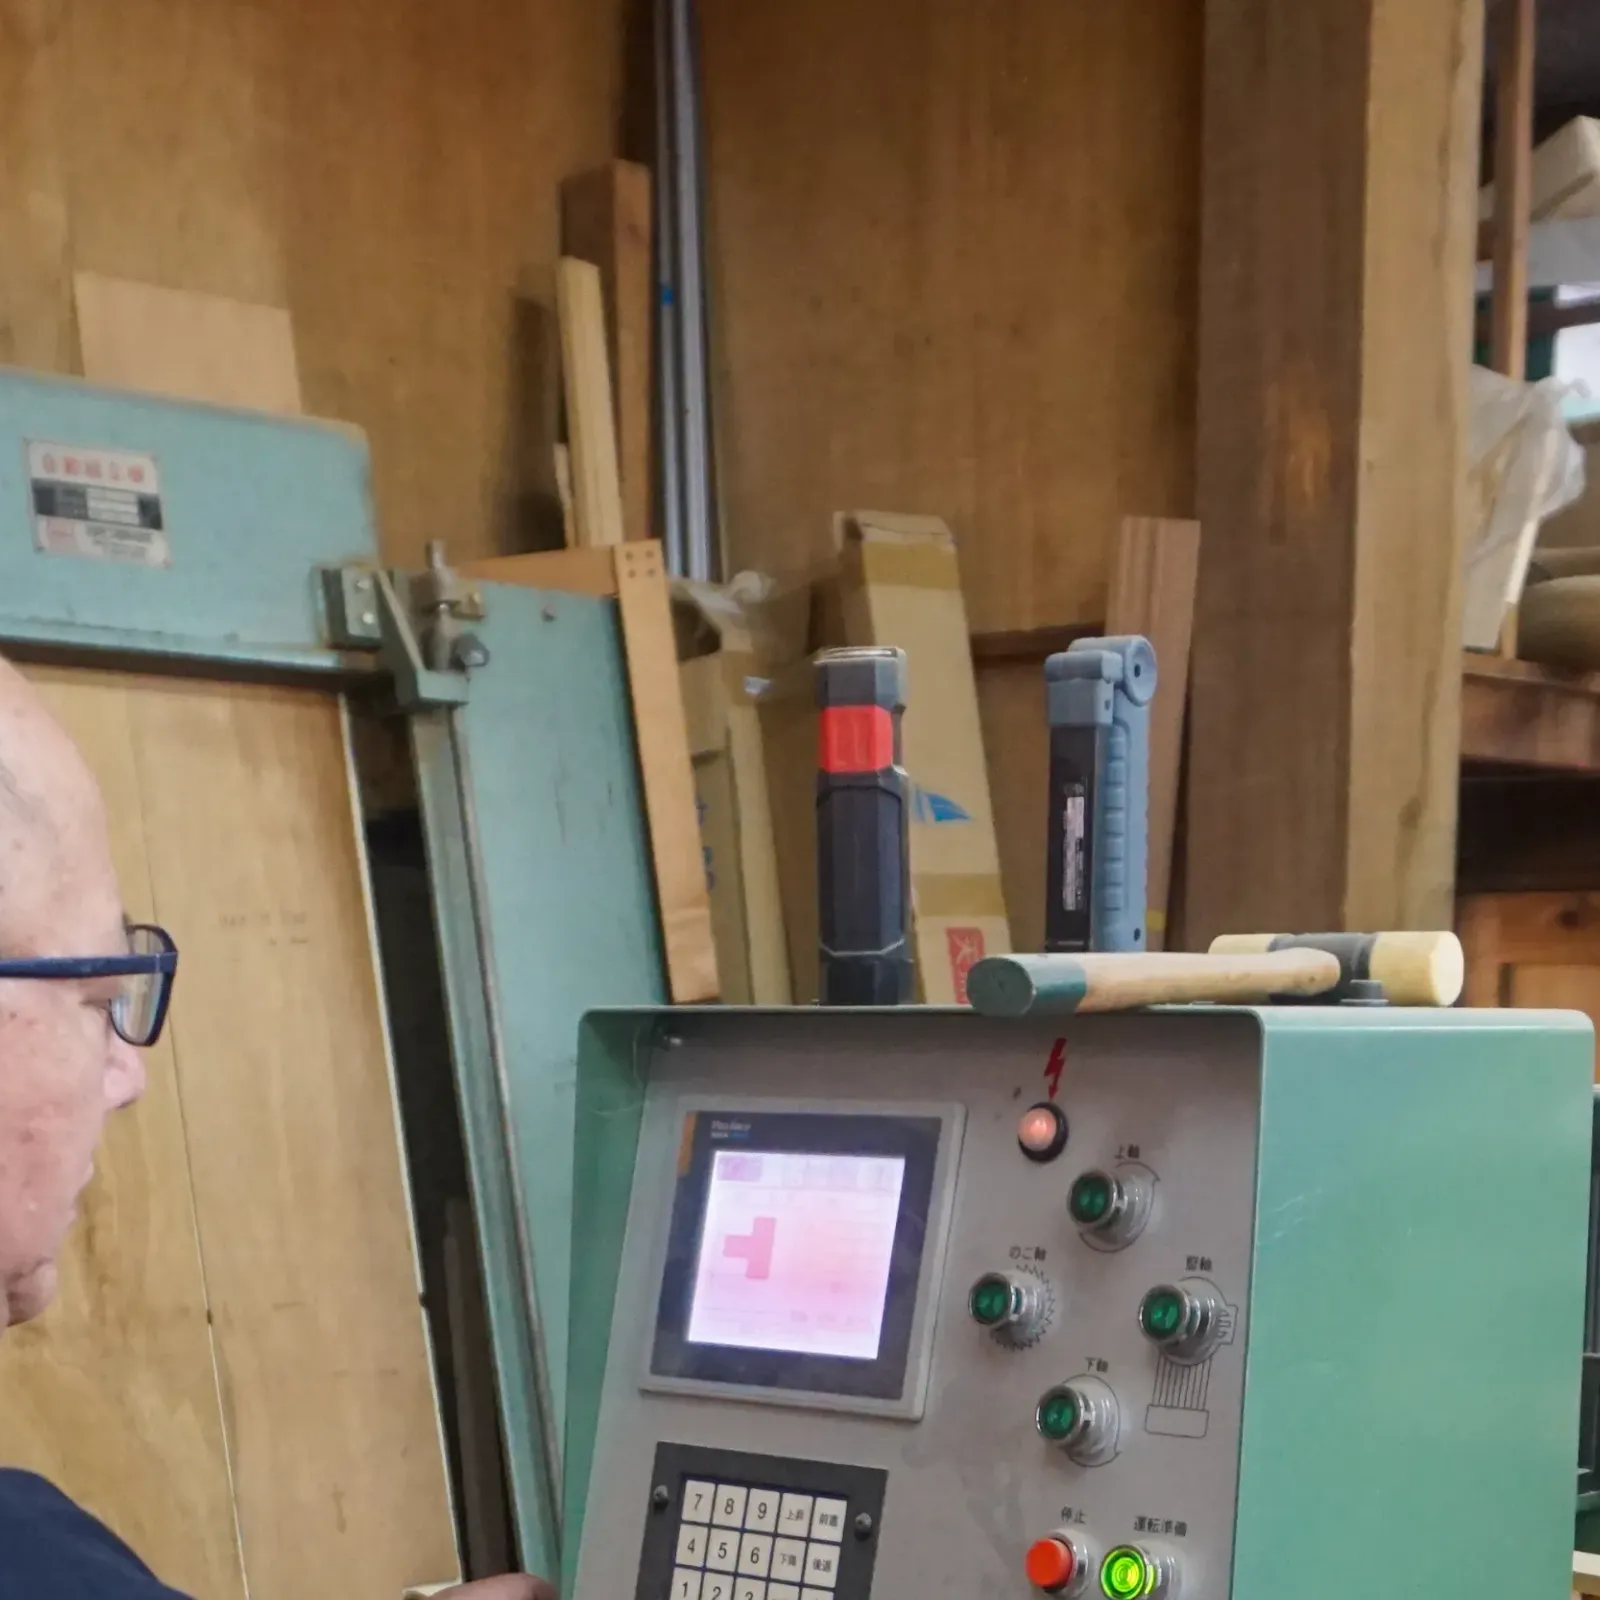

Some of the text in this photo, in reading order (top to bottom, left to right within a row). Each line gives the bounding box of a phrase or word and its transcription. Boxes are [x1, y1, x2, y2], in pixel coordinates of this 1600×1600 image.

[694, 1493, 703, 1511] 7
[725, 1499, 734, 1515] 8
[758, 1502, 767, 1519] 9
[1060, 1505, 1087, 1524] 停止
[1133, 1515, 1188, 1537] 運転準備
[687, 1538, 696, 1554] 4
[718, 1542, 727, 1559] 5
[750, 1547, 760, 1564] 6
[682, 1582, 689, 1598] 1
